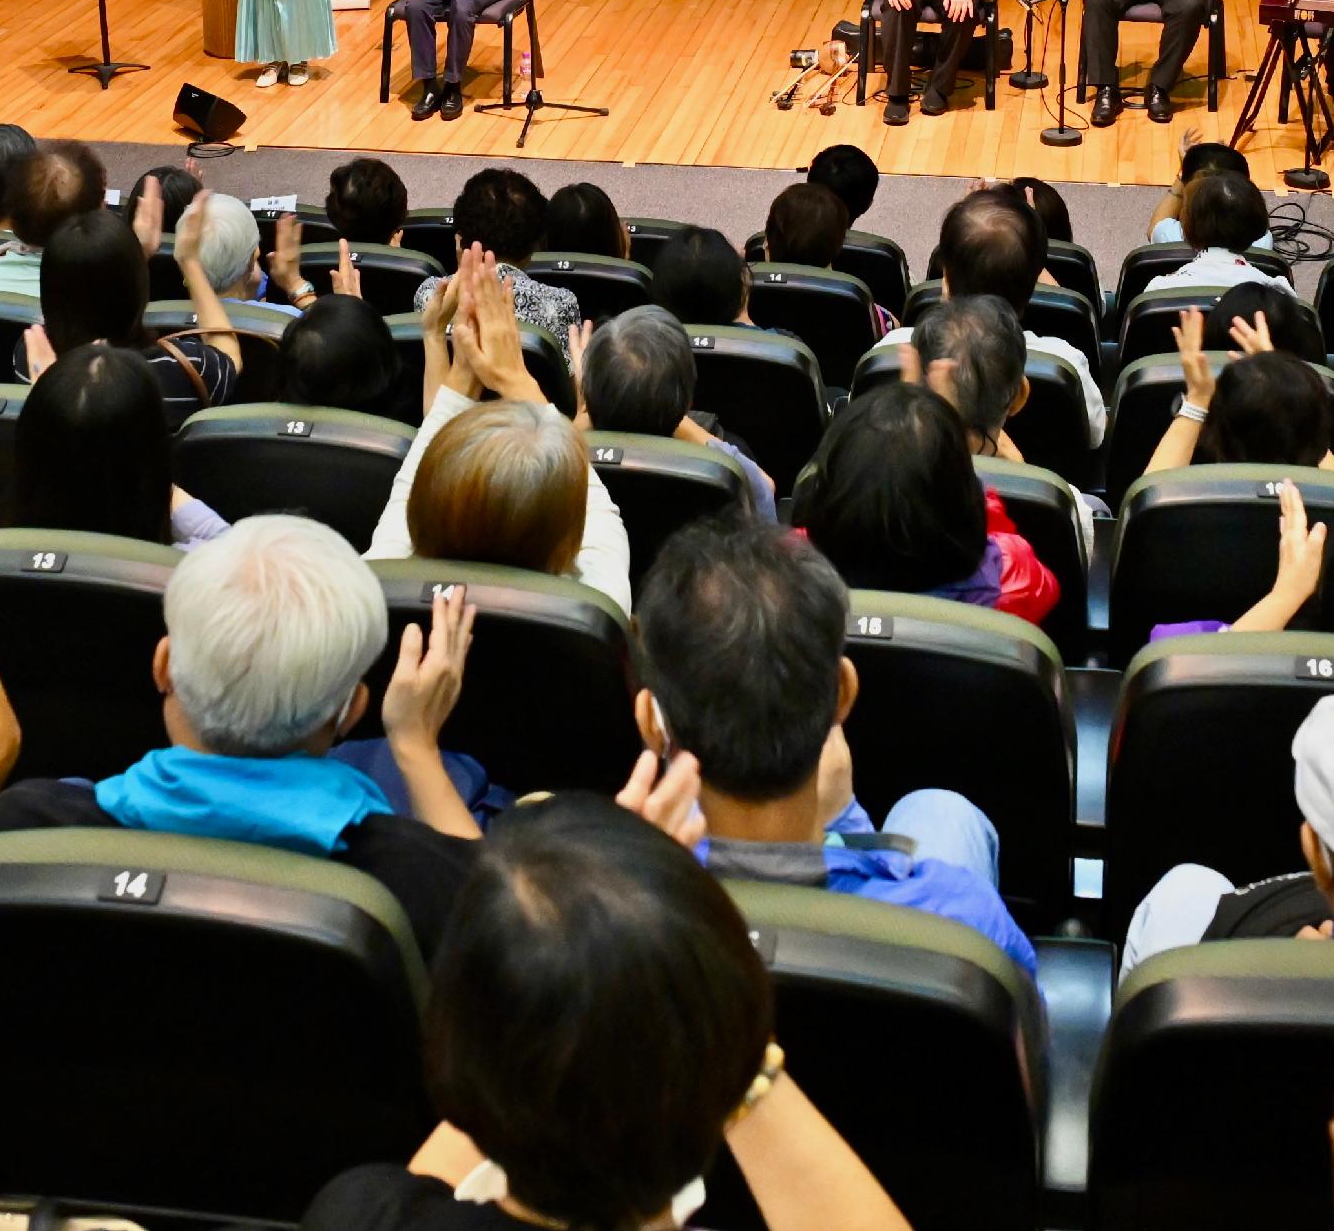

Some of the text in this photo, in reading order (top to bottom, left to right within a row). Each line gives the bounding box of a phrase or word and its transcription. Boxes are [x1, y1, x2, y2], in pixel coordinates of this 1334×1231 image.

[694, 338, 708, 346] 14
[287, 422, 304, 433] 13
[597, 449, 613, 460] 14
[33, 553, 55, 568] 13
[1307, 659, 1332, 676] 16
[115, 872, 147, 897] 14
